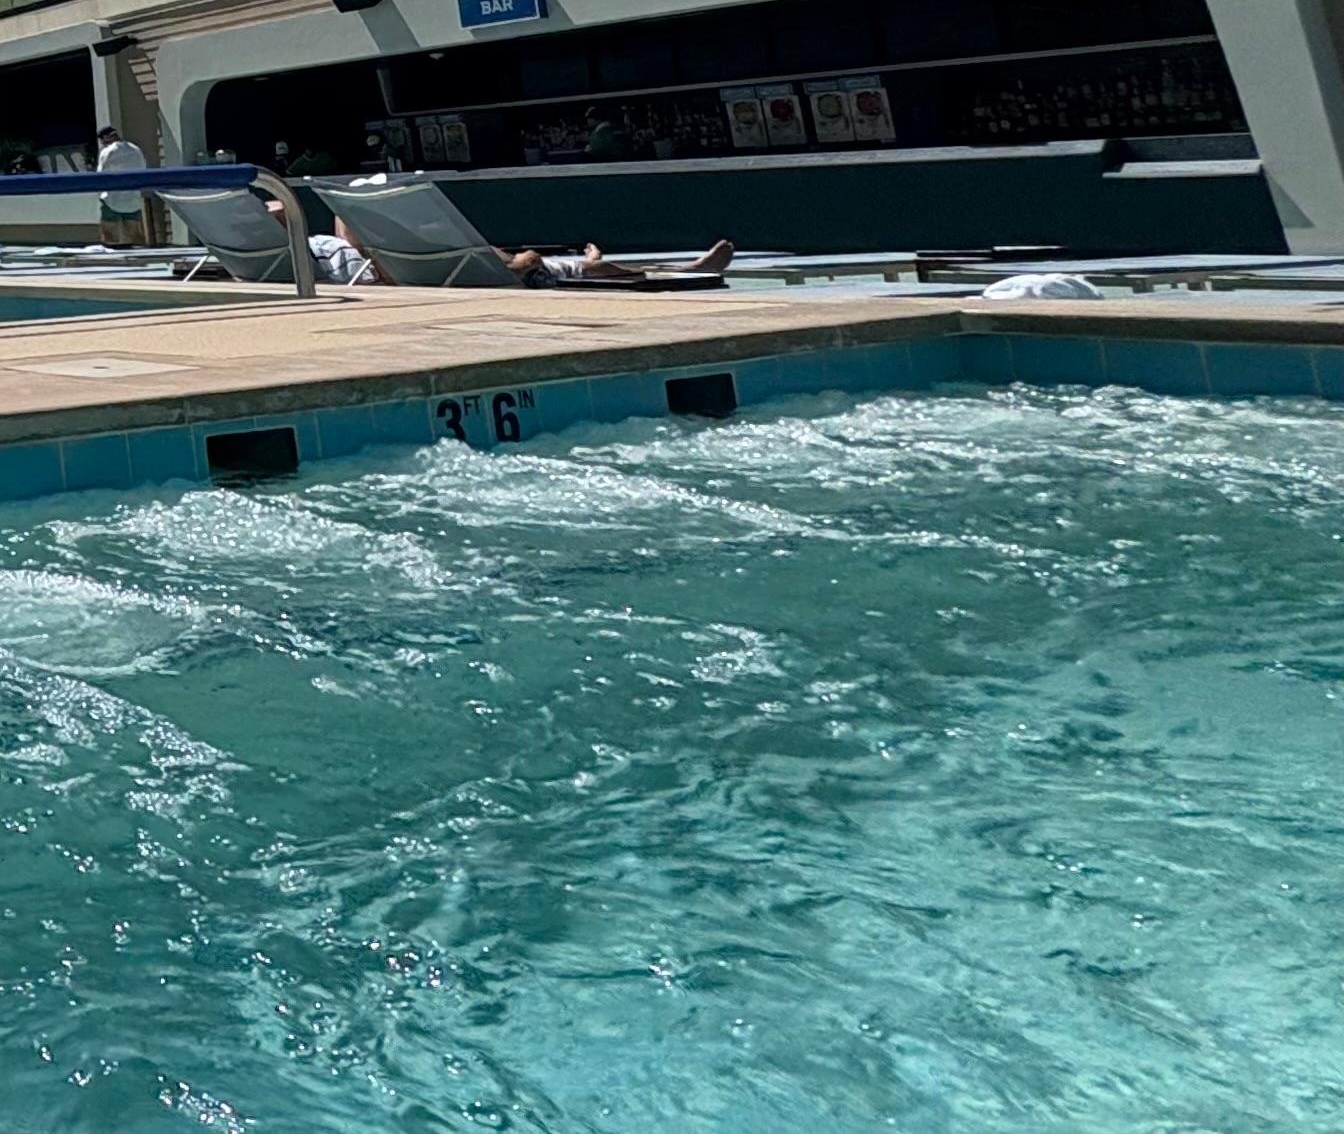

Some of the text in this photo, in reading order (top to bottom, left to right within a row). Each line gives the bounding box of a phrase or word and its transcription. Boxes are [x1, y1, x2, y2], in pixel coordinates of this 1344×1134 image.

[436, 387, 535, 443] 3 FT 6 IN
